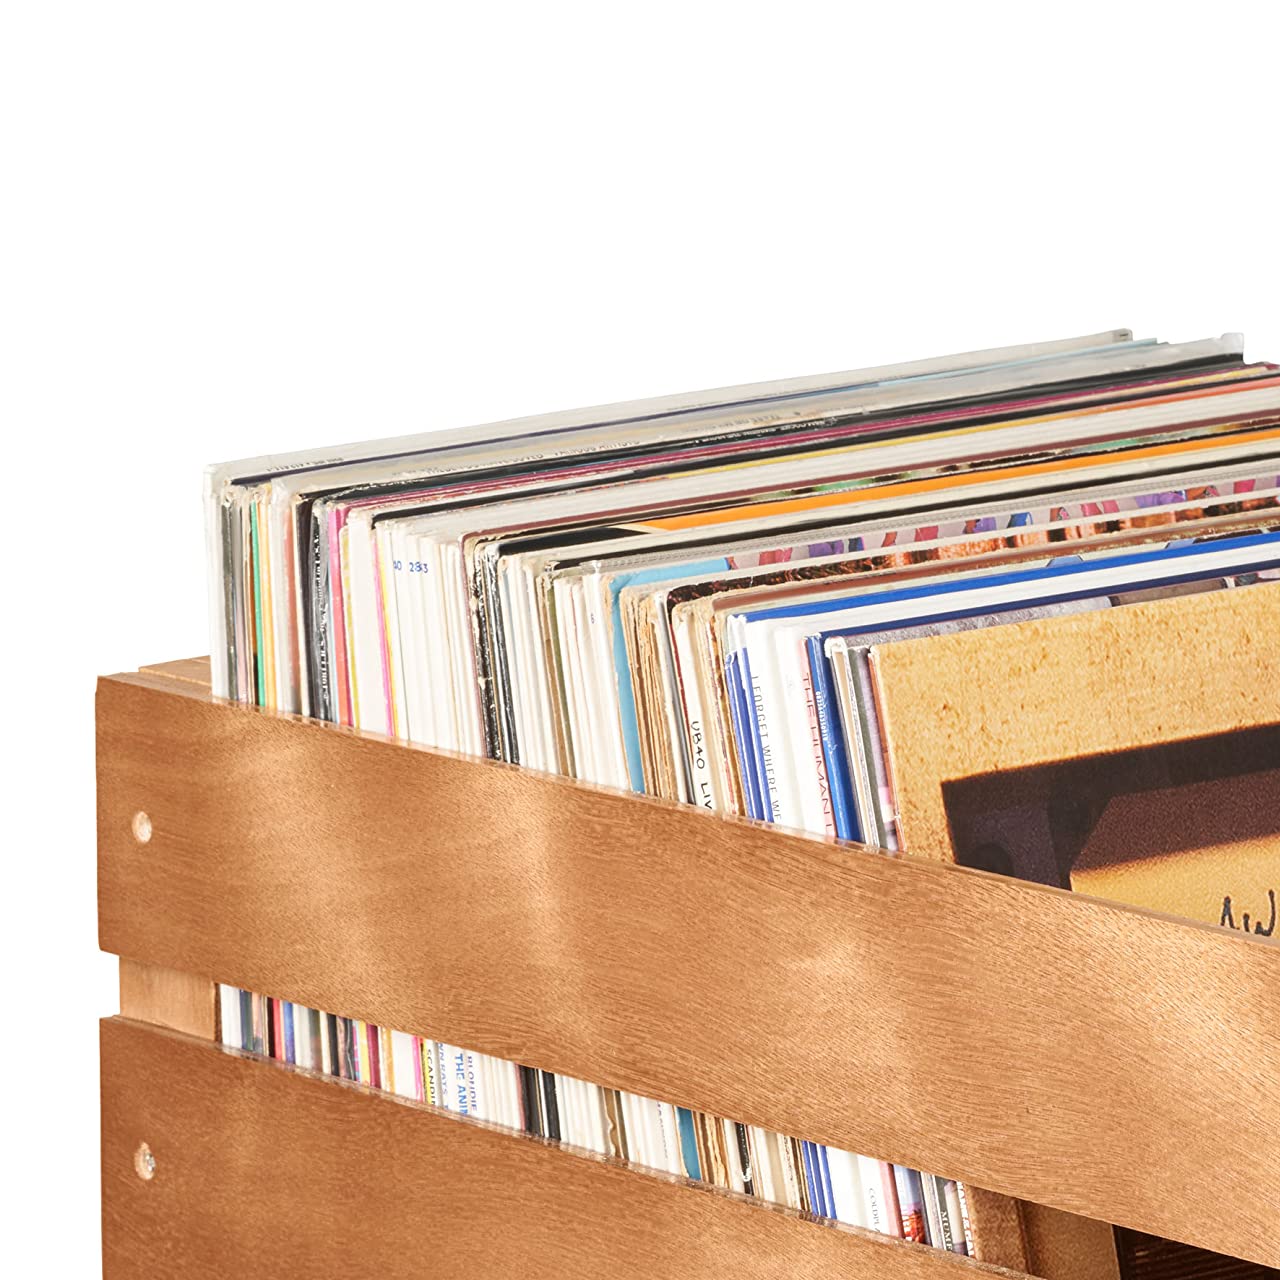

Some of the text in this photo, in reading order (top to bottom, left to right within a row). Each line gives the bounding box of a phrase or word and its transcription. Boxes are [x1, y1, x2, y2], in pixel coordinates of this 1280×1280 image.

[690, 720, 706, 770] UB40
[753, 685, 769, 739] FORGET
[763, 744, 778, 794] WHERE
[802, 672, 815, 718] THE
[810, 725, 831, 815] HUMAN
[455, 1053, 465, 1081] THE
[467, 1055, 478, 1112] BLONDIE
